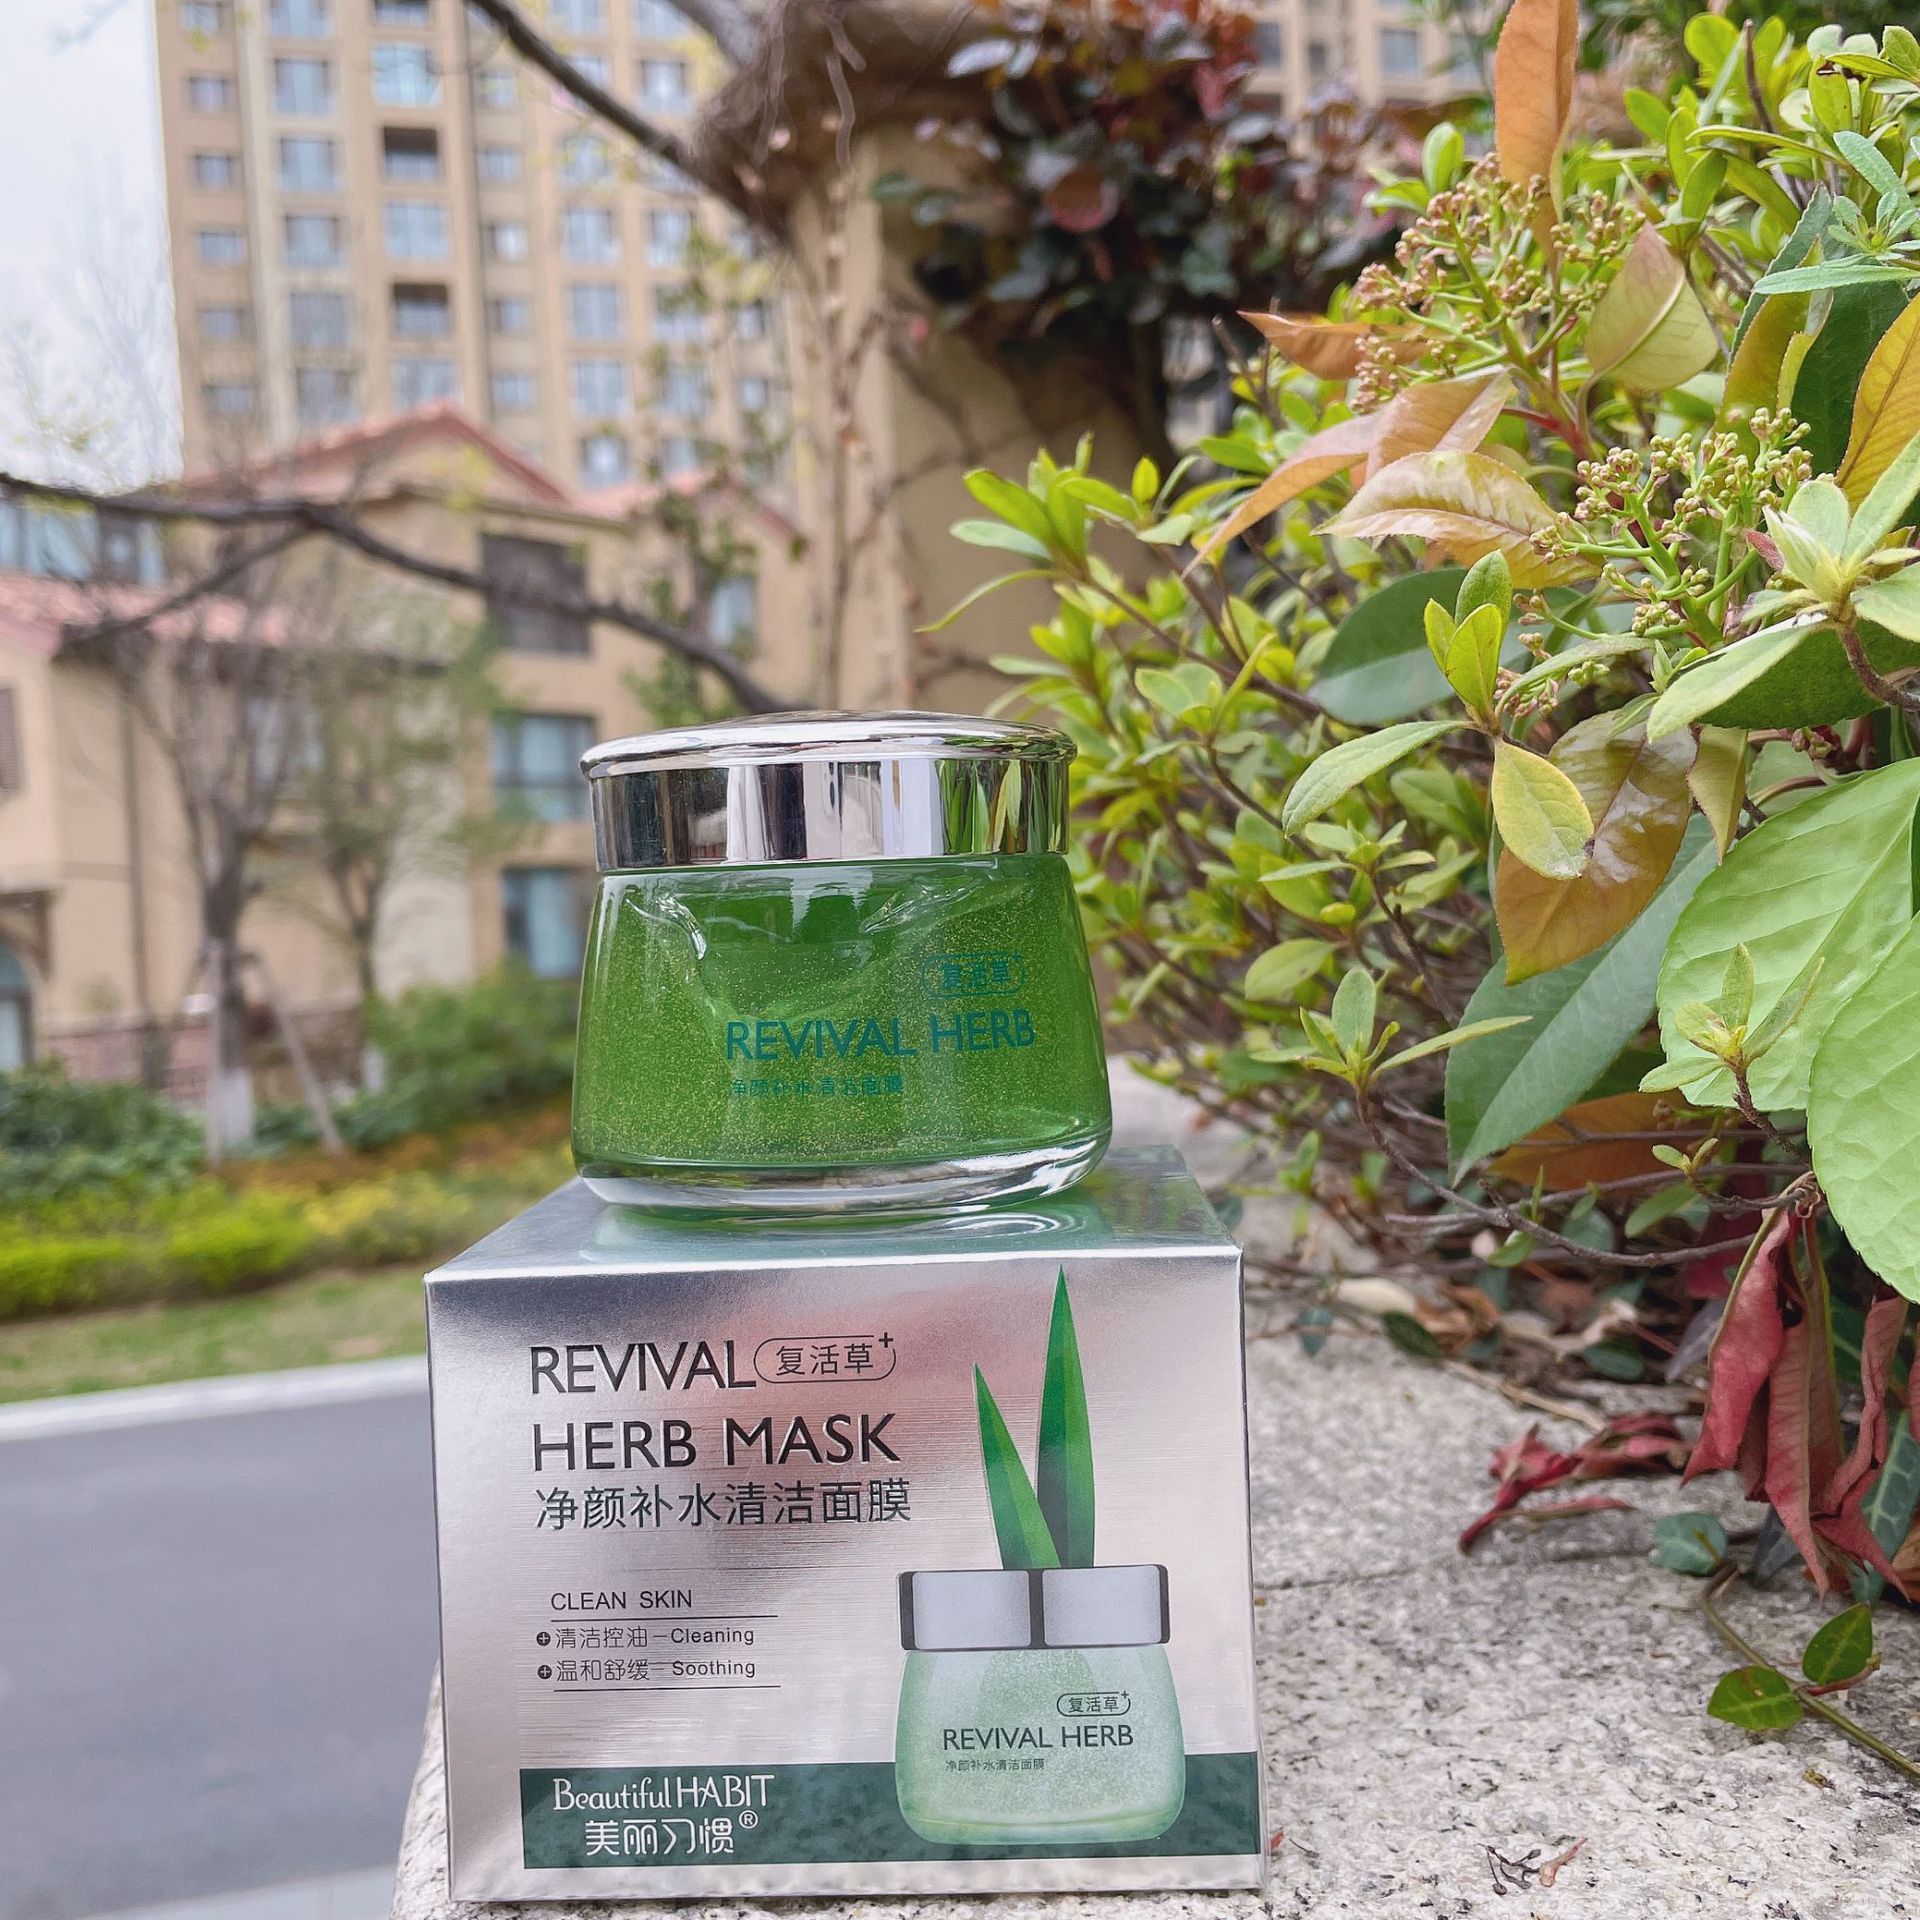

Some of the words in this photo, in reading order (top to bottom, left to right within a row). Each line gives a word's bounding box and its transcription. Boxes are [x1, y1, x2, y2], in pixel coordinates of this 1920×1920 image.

[727, 1016, 918, 1060] REVIVAL
[931, 1008, 1036, 1052] HERB
[530, 1340, 757, 1394] REVIVAL
[533, 1420, 697, 1471] HERB
[725, 1413, 901, 1466] MASK
[536, 1478, 911, 1529] 净颜补水清洁面膜
[551, 1591, 626, 1610] CLEAN
[640, 1590, 692, 1609] SKIN
[943, 1726, 1053, 1750] REVIVAL
[1062, 1724, 1134, 1748] HERB
